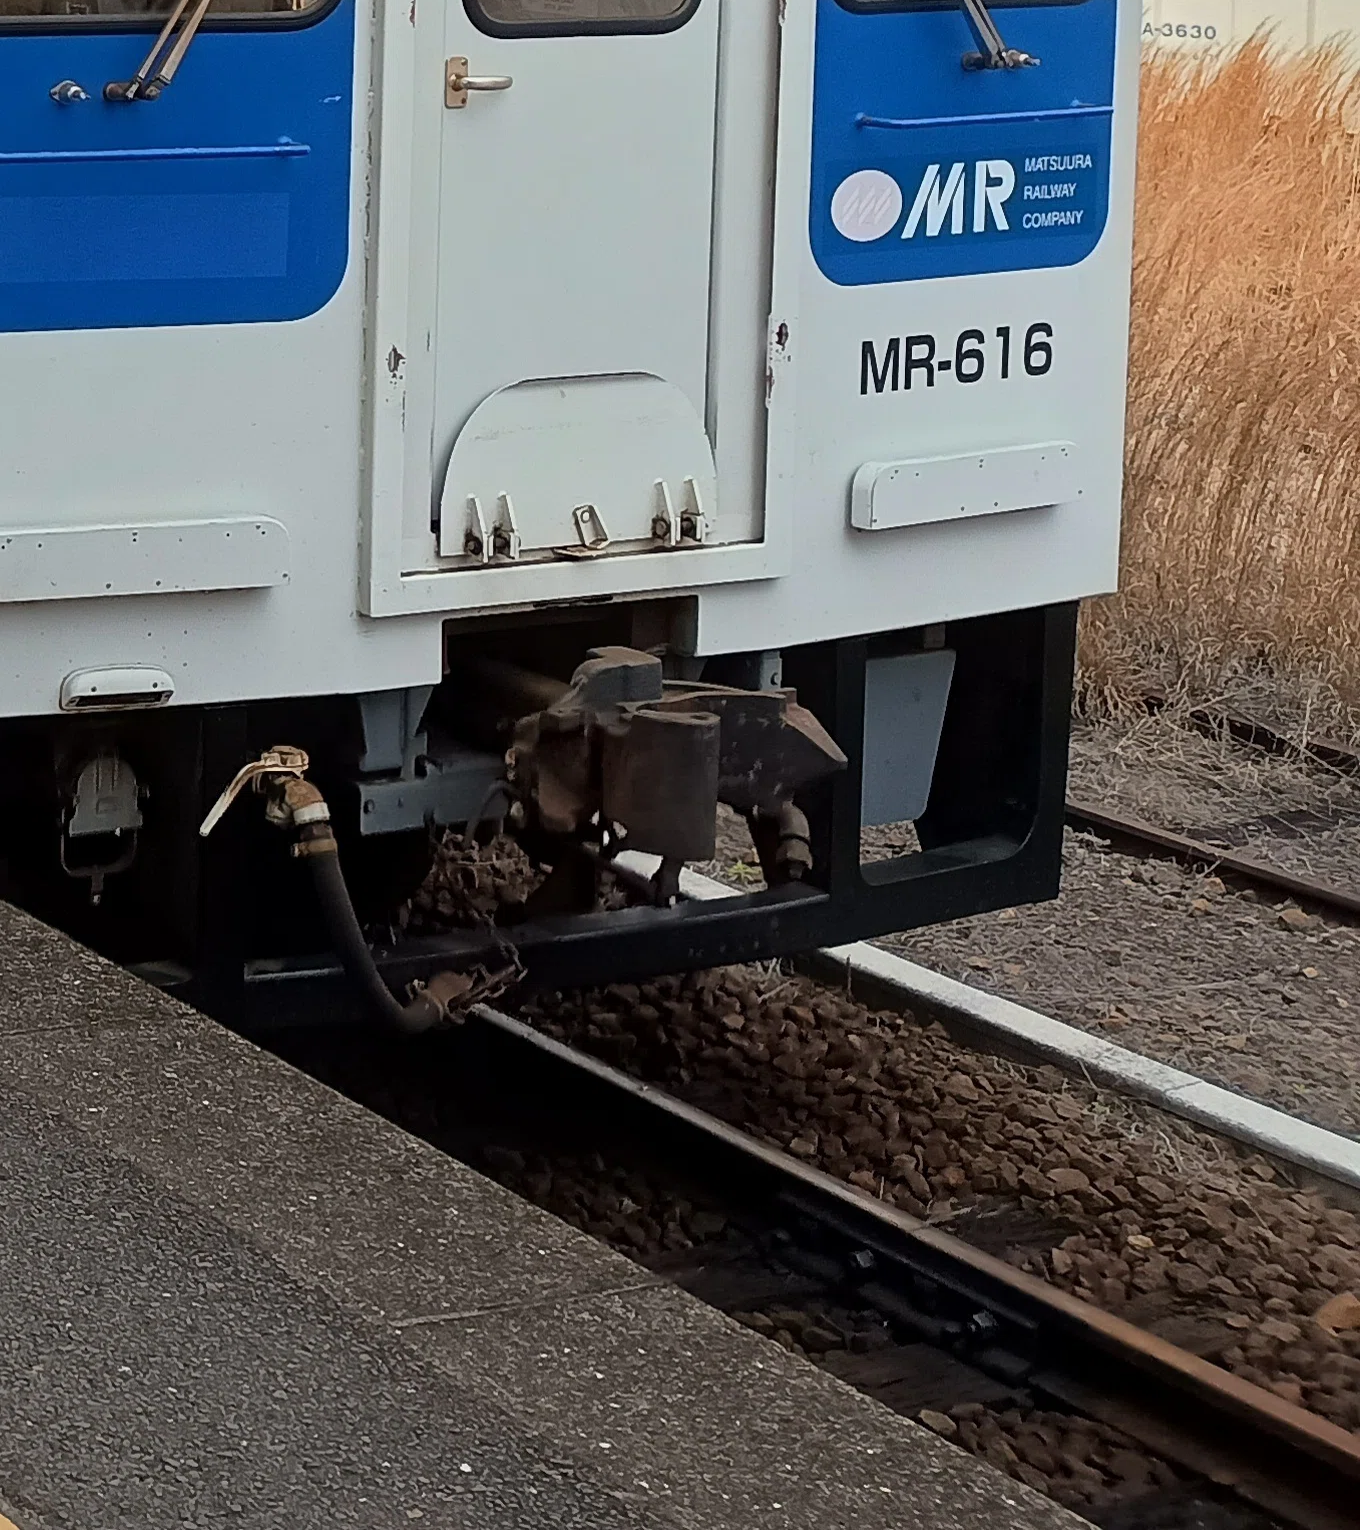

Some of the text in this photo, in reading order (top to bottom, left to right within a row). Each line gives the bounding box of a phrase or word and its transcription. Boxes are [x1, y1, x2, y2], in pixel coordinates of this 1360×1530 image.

[1024, 154, 1093, 173] MATSUURA
[901, 159, 1016, 239] MR
[1023, 183, 1077, 201] RAILWAY
[1022, 210, 1084, 229] COMPANY
[860, 322, 1053, 396] MR-616
